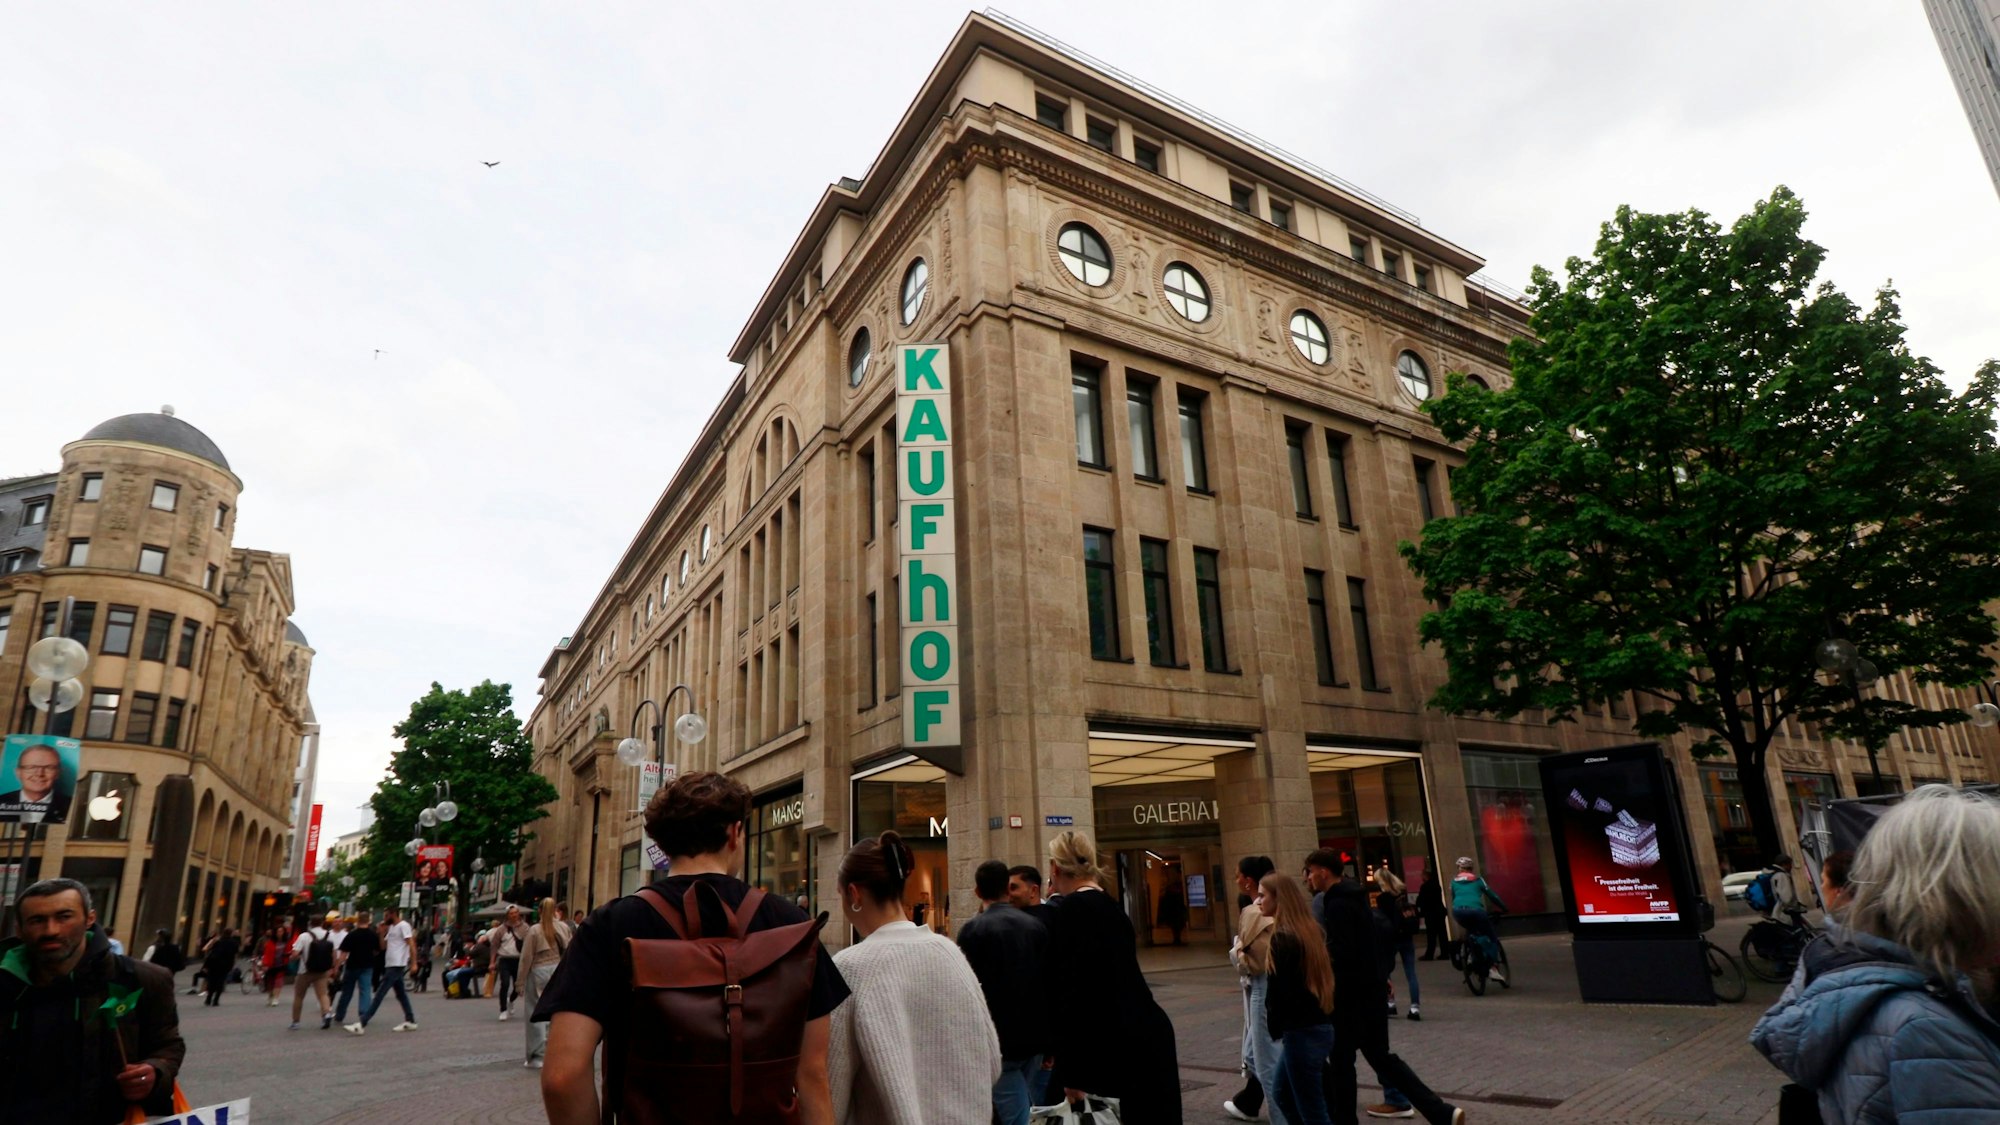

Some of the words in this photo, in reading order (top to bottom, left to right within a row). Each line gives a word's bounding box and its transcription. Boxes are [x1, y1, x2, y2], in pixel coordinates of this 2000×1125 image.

[23, 803, 48, 811] Voss
[1133, 801, 1211, 825] GALERIA
[308, 824, 320, 851] UNIQLO
